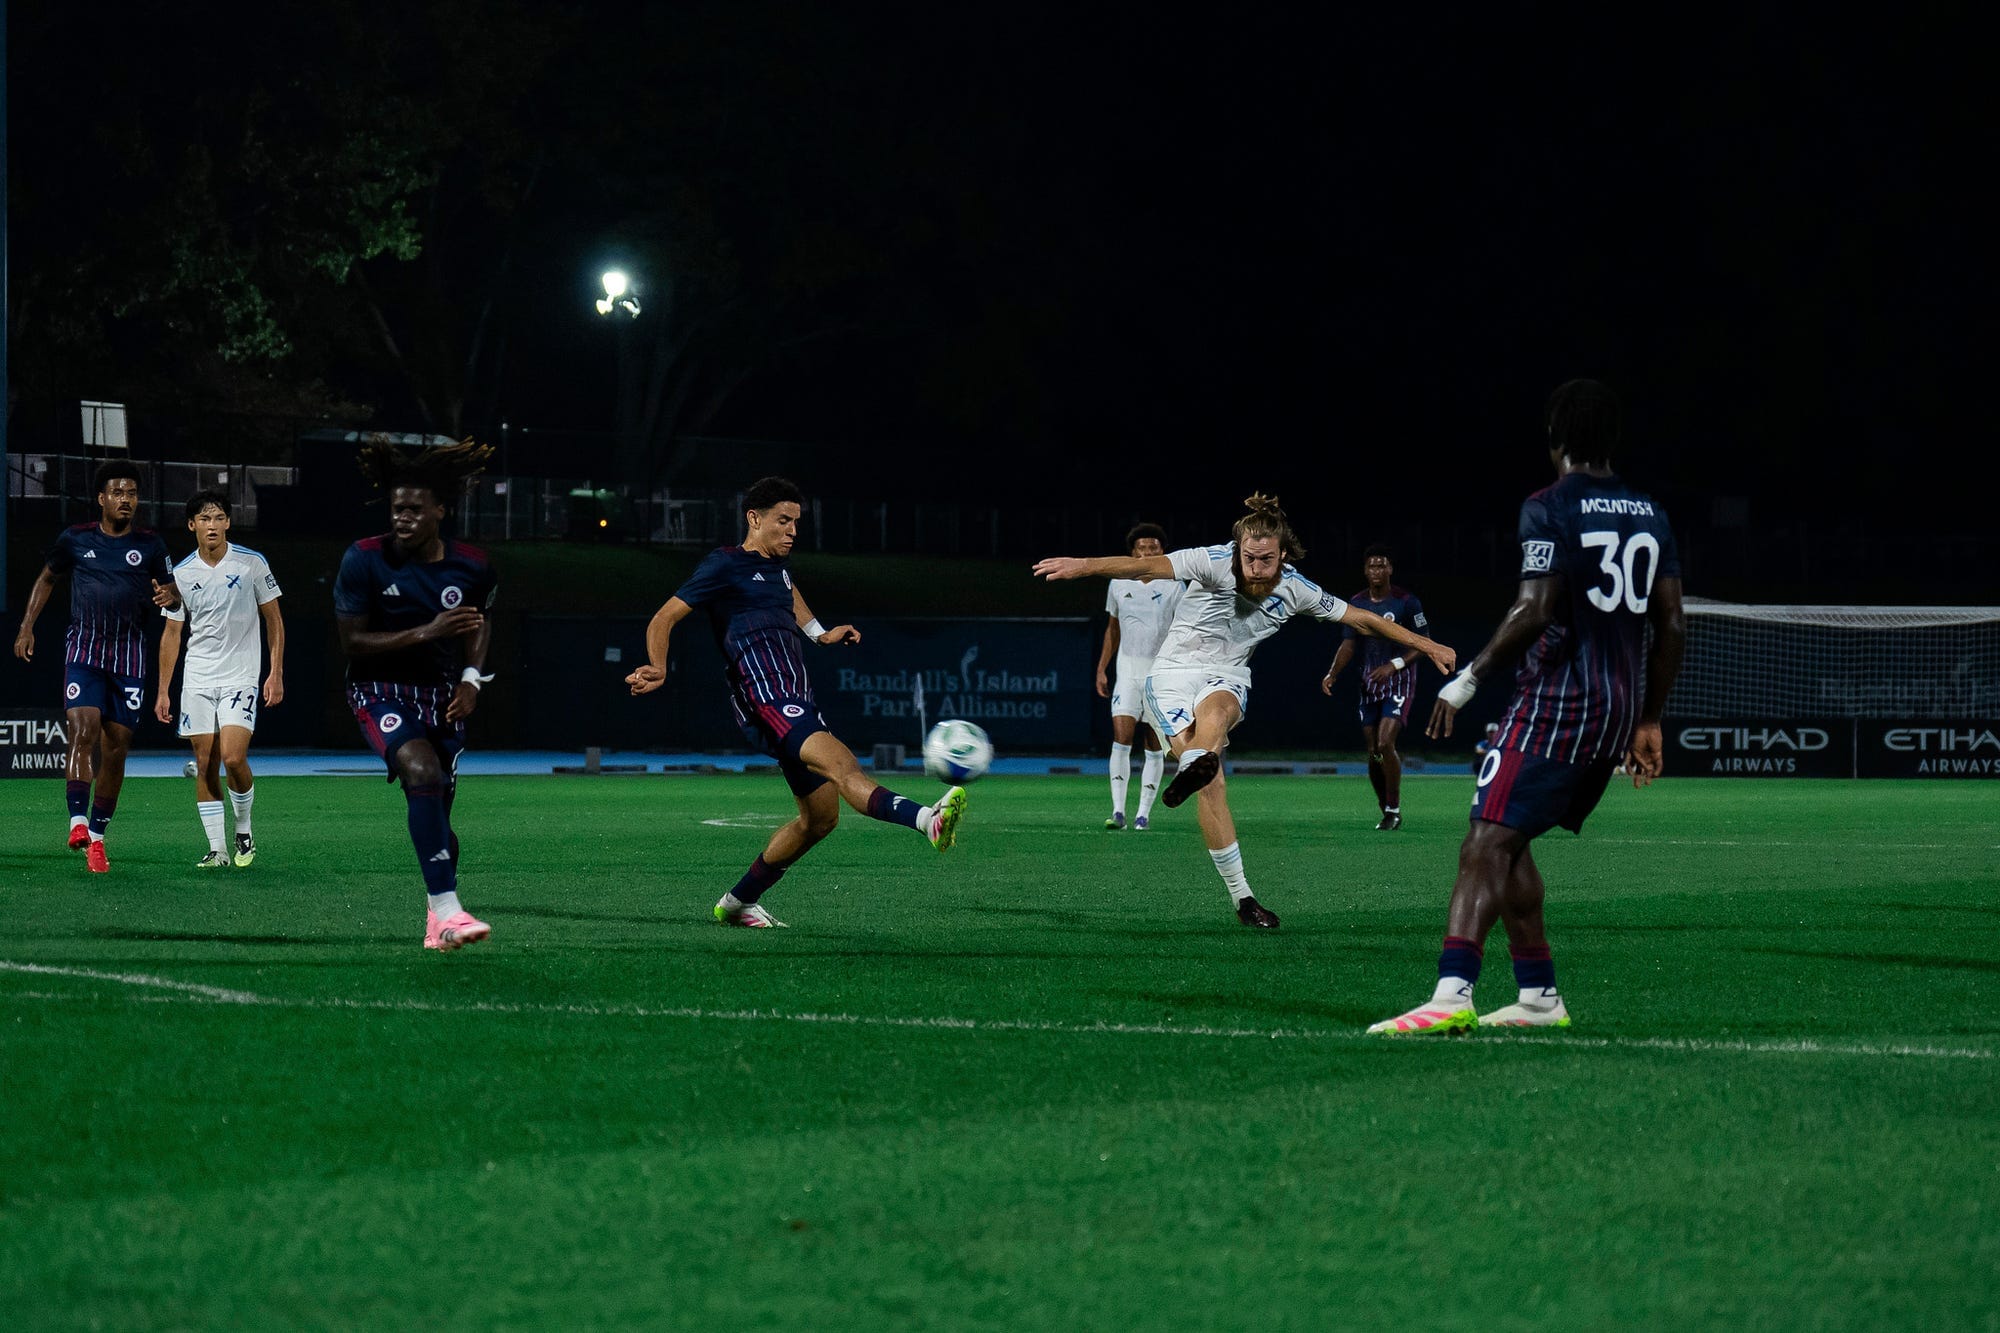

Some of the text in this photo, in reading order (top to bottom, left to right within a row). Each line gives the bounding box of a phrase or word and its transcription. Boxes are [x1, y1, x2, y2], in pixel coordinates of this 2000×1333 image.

[1580, 498, 1654, 517] MCINTOSH
[1580, 531, 1660, 614] 30
[976, 670, 1058, 692] Island
[937, 694, 1047, 718] Alliance
[1678, 727, 1830, 750] ETIHAD
[11, 753, 67, 769] AIRWAYS
[1712, 757, 1797, 773] AIRWAYS
[1918, 758, 2000, 773] AIRWAYS
